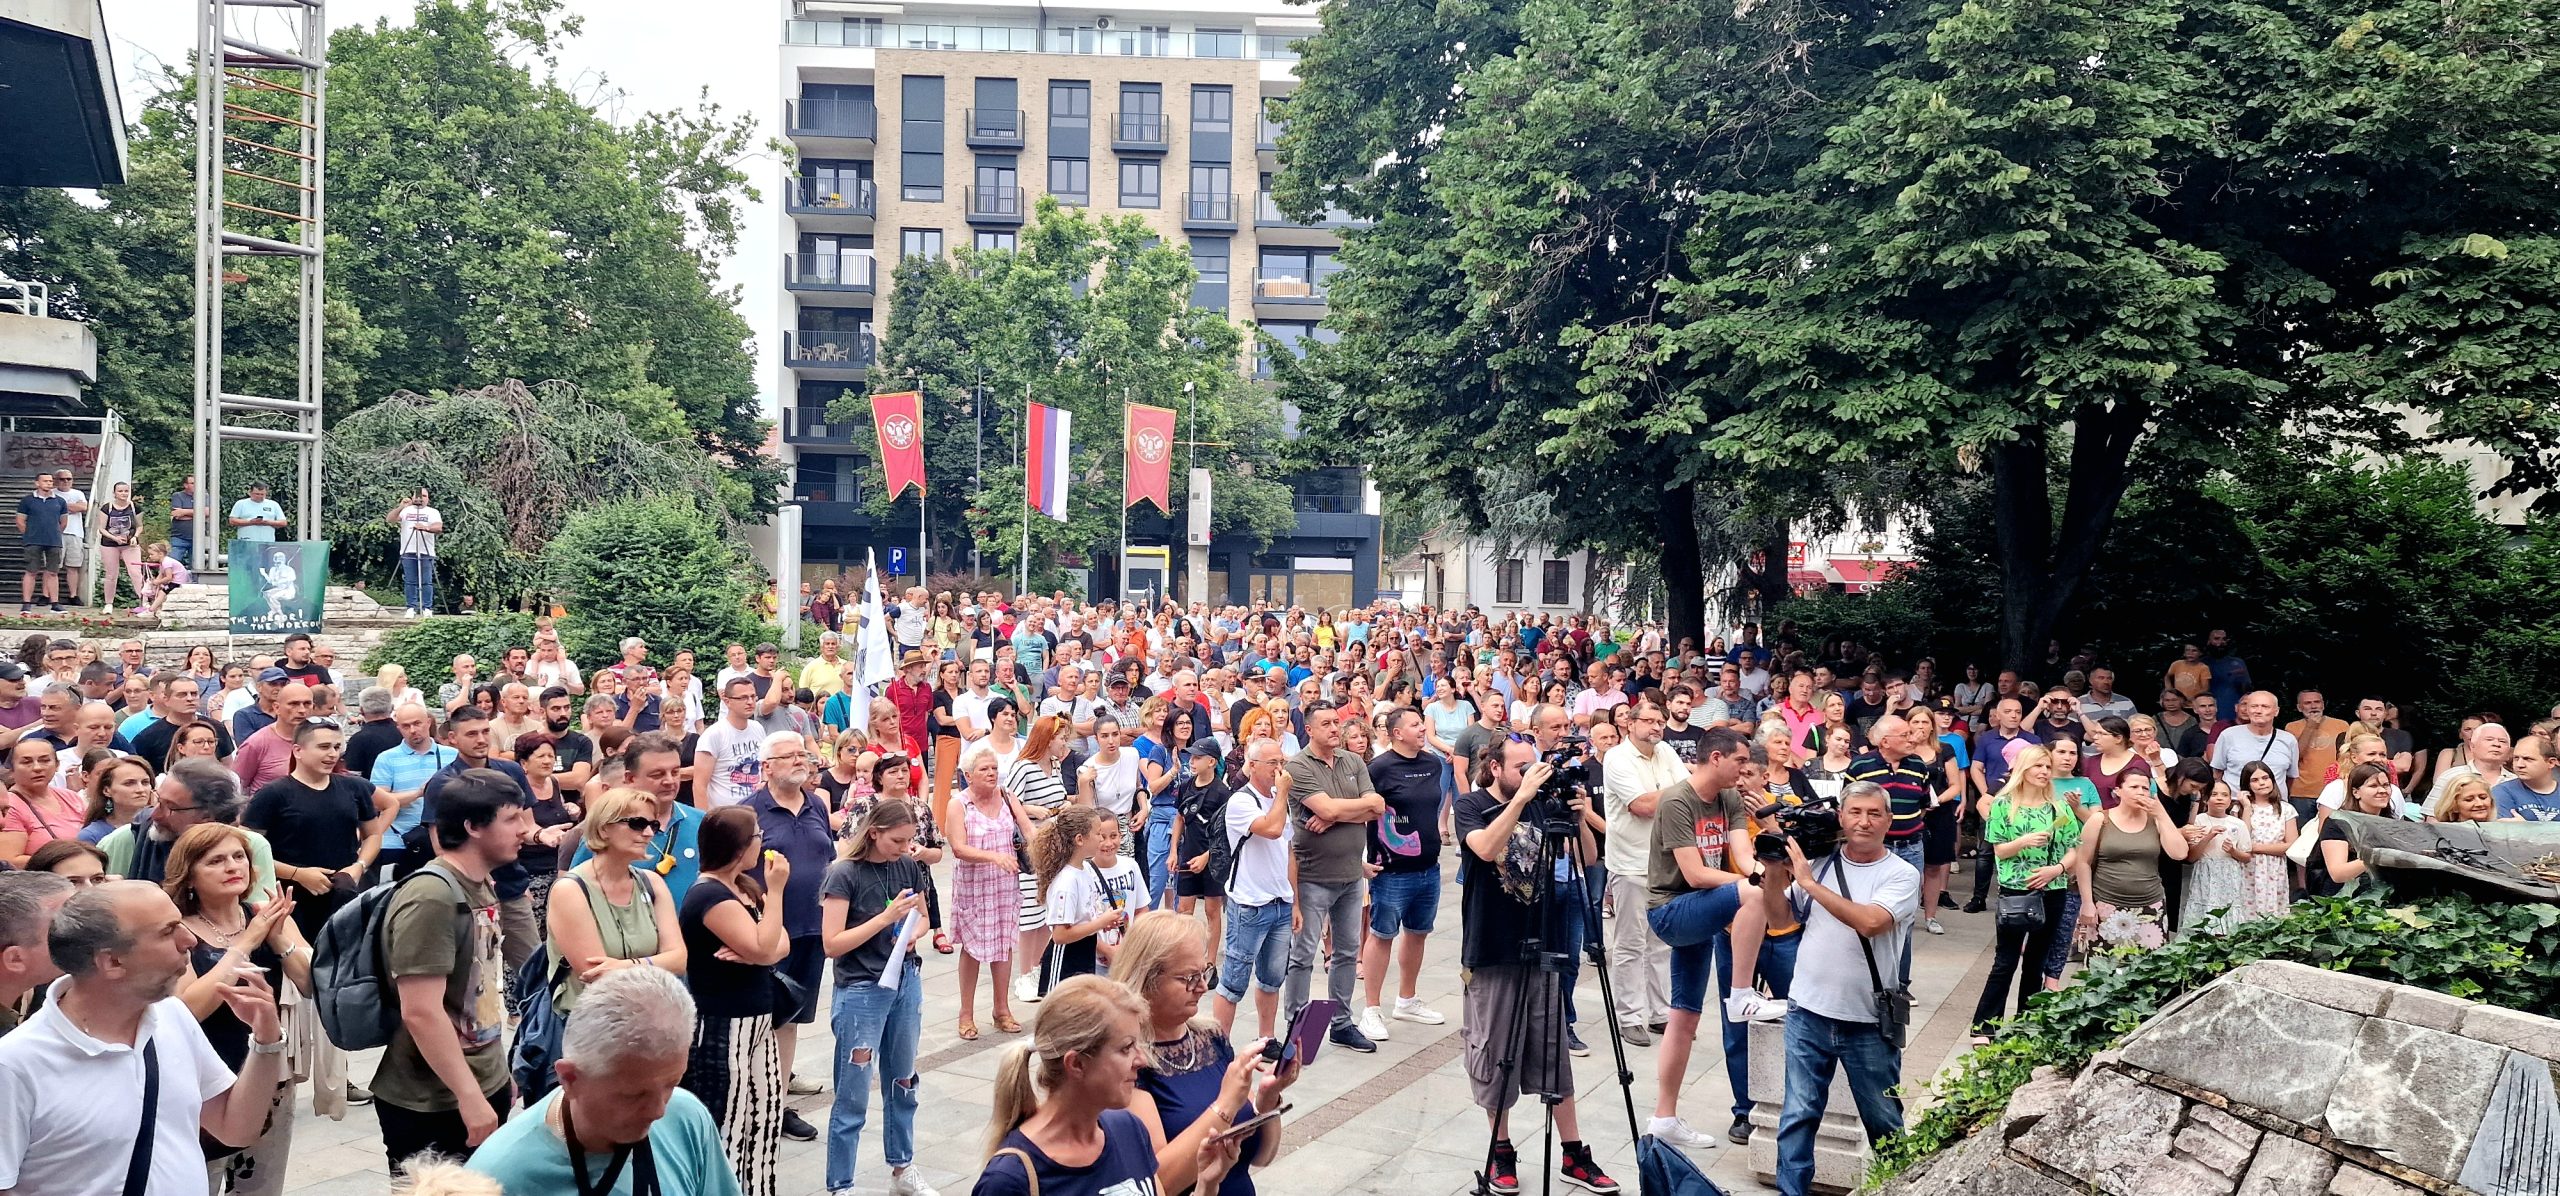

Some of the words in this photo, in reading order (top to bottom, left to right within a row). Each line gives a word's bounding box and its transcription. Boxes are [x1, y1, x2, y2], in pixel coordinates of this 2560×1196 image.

[892, 549, 902, 563] P
[229, 616, 248, 625] THE
[250, 622, 272, 631] THE
[731, 740, 760, 756] BLACK
